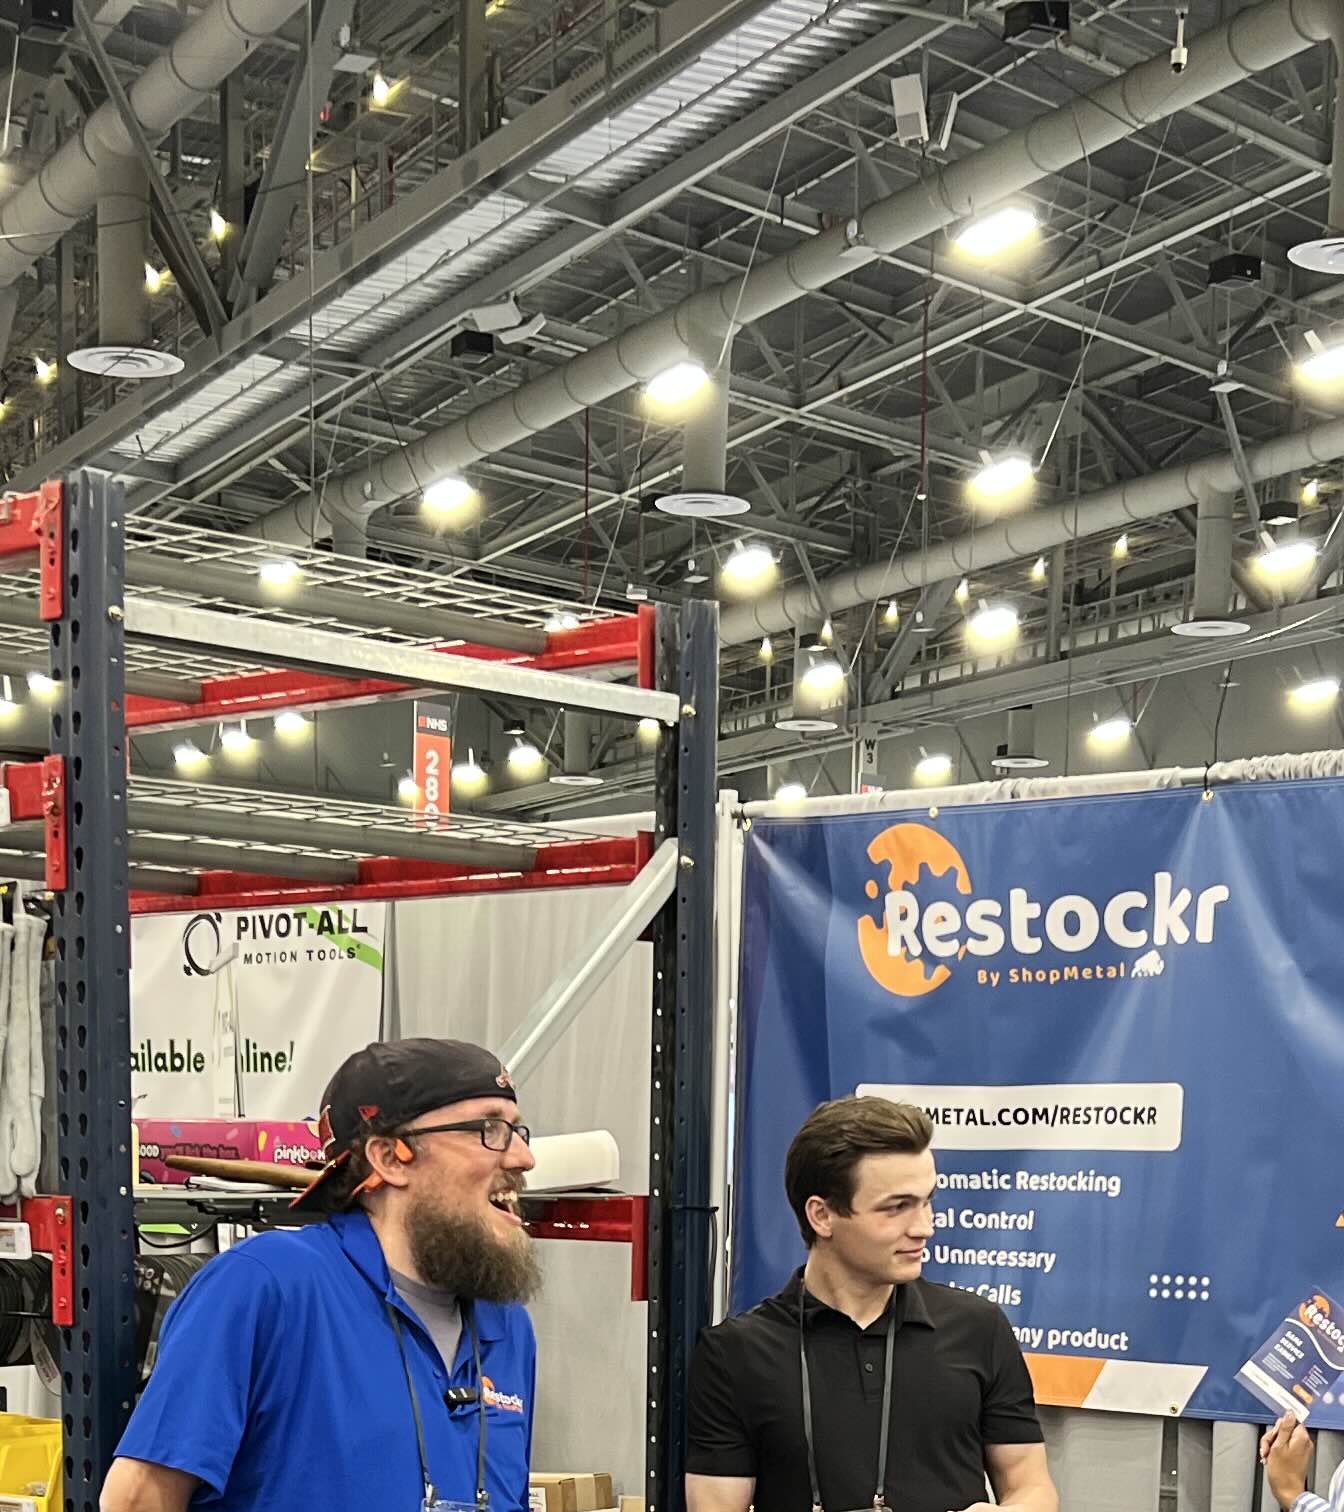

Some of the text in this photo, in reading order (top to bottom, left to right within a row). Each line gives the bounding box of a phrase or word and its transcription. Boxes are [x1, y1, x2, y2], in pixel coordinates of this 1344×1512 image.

[426, 716, 448, 733] NHS
[236, 908, 369, 941] PIVOT-ALL
[885, 871, 1230, 958] Restockr
[242, 945, 357, 965] MOTION TOOLS
[977, 962, 1126, 987] By ShopMetal
[130, 1039, 295, 1073] ailable line!
[925, 1104, 1158, 1129] METAL.COM/RESTOCKR
[936, 1169, 1122, 1198] omatic Restocking
[930, 1208, 1035, 1232] tal Control
[934, 1245, 1057, 1274] Unnecessary
[1047, 1327, 1129, 1352] product
